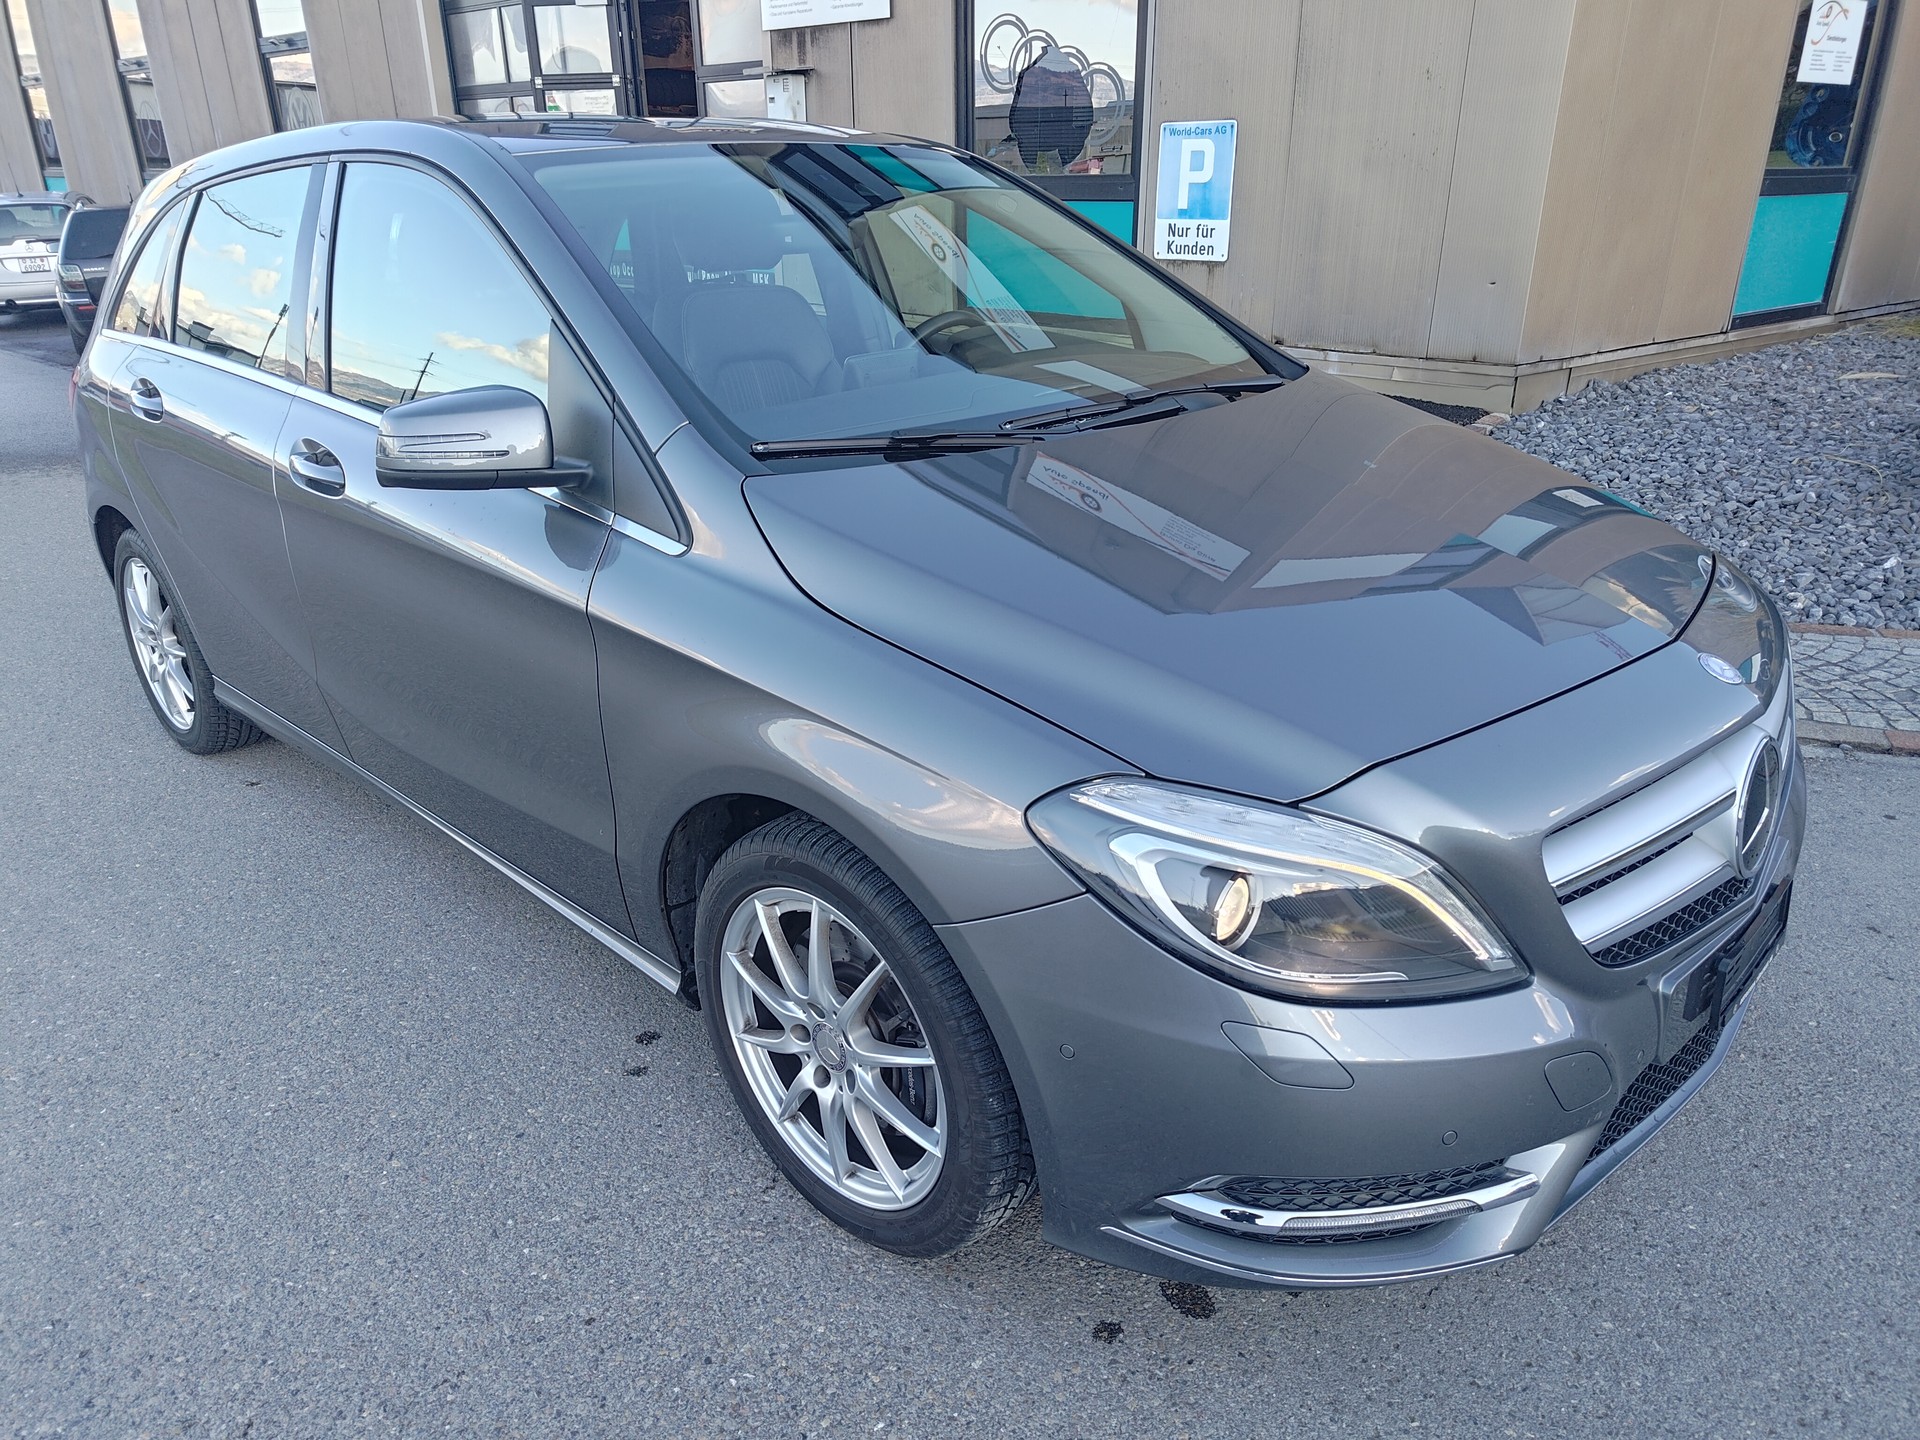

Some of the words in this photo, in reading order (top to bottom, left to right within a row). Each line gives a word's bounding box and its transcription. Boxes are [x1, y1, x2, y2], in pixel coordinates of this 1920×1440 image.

[1168, 126, 1213, 137] World-Cars
[1214, 125, 1227, 136] AG
[1177, 138, 1216, 210] P
[1167, 222, 1191, 239] Nur
[1195, 223, 1216, 239] für
[1166, 240, 1215, 256] Kunden
[24, 263, 46, 272] 69092
